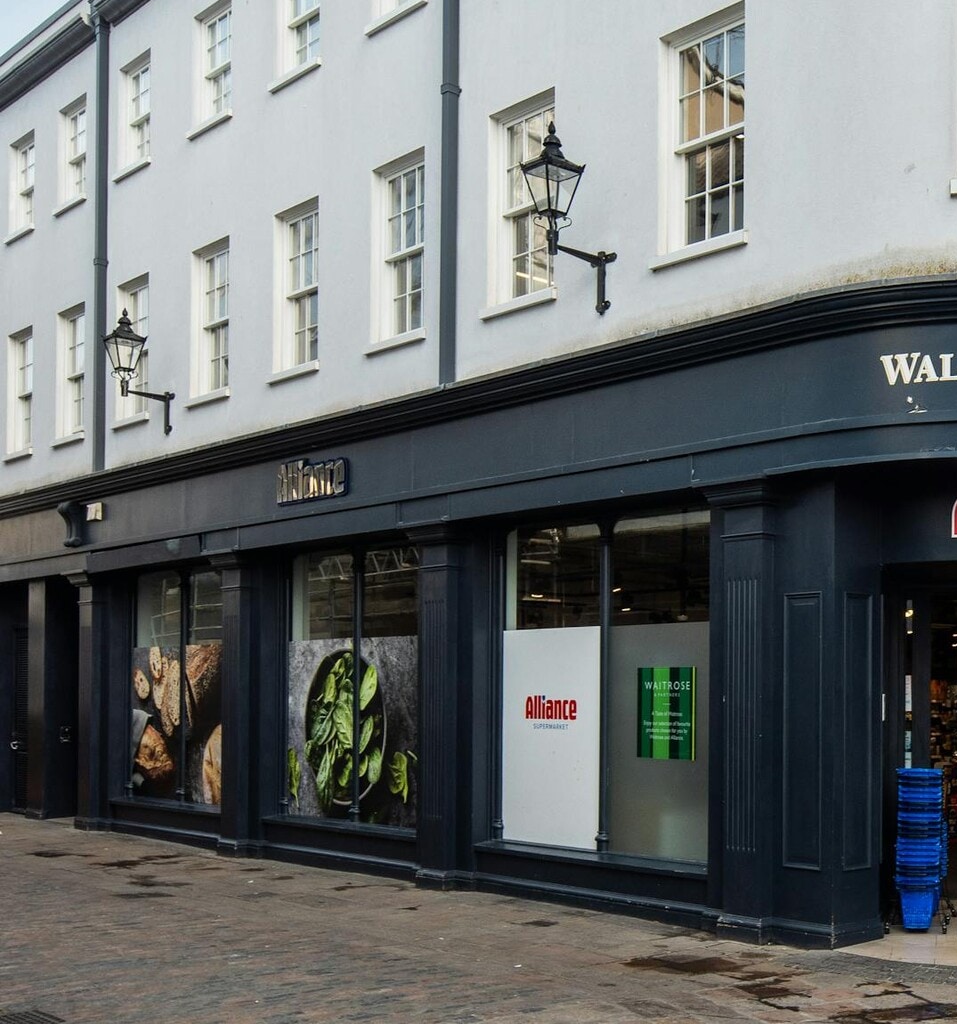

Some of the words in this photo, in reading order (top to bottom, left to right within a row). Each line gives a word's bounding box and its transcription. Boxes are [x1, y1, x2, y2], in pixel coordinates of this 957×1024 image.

[276, 458, 348, 505] Alliance
[644, 680, 691, 690] WAITROSE
[525, 694, 577, 721] Alliance
[533, 722, 569, 731] SUPERMARKET
